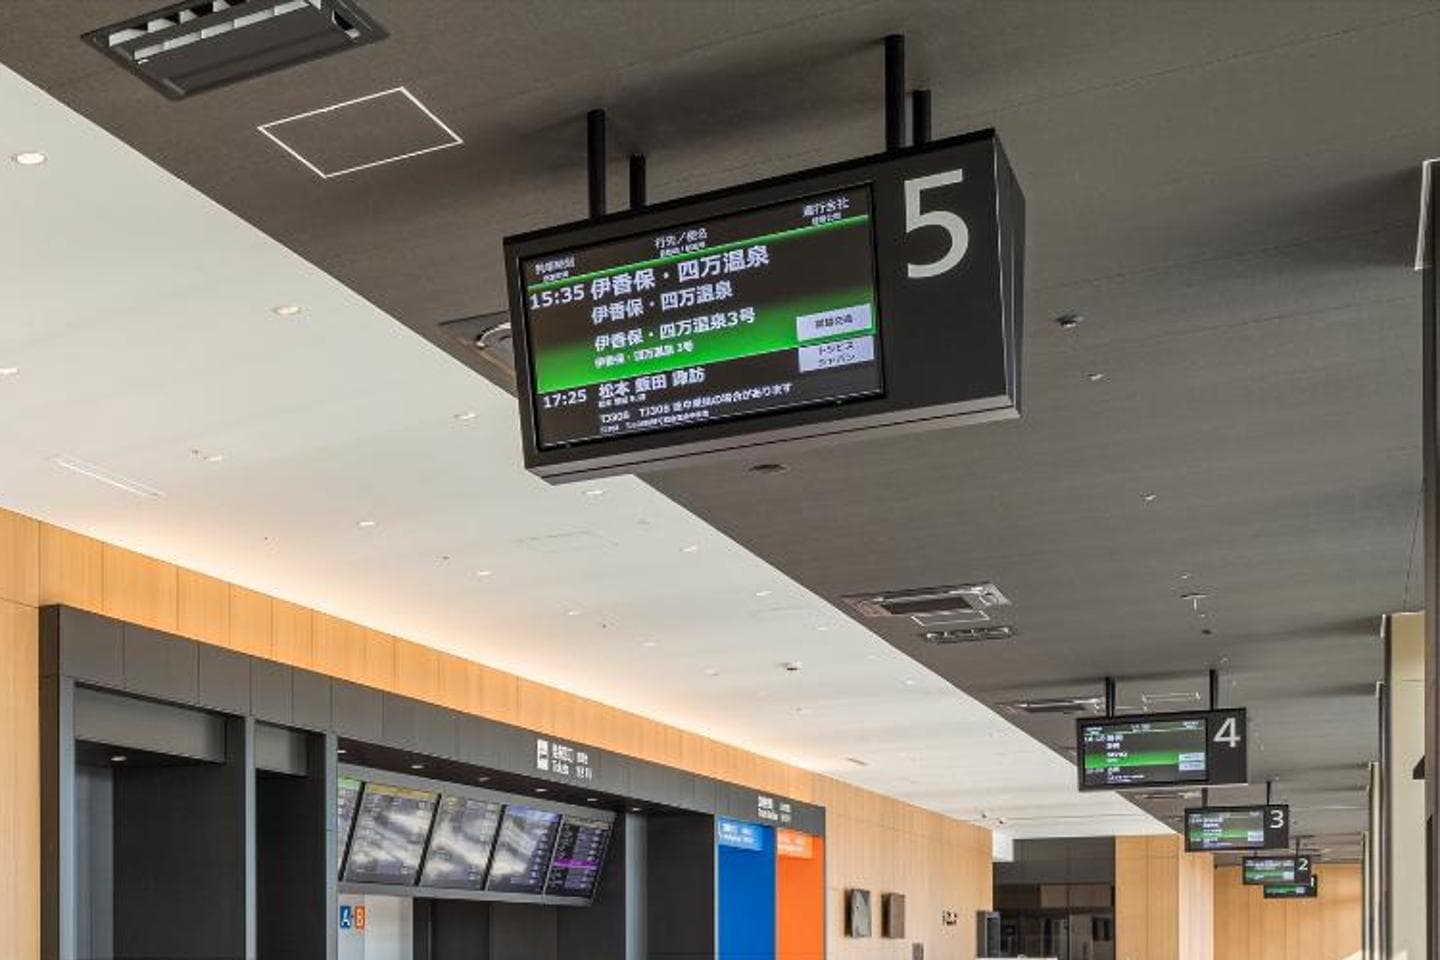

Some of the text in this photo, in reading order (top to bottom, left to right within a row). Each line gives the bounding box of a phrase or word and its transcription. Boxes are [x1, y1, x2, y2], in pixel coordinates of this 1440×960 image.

[904, 168, 969, 278] 5
[529, 284, 585, 311] 15:35
[543, 388, 587, 409] 17:25
[1214, 717, 1240, 748] 4
[1270, 809, 1284, 829] 3
[1298, 858, 1308, 871] 2
[341, 907, 364, 927] A B
